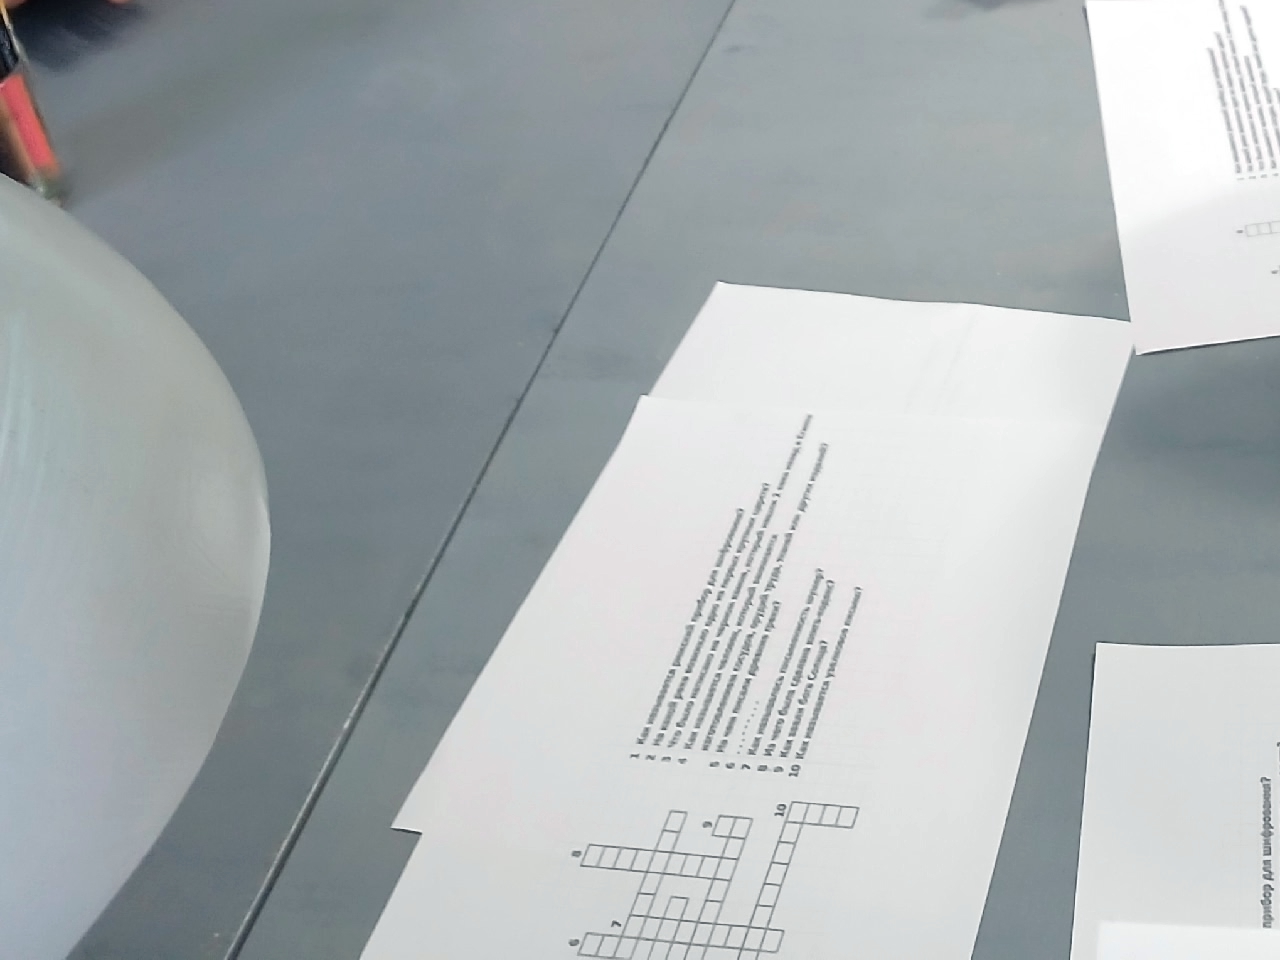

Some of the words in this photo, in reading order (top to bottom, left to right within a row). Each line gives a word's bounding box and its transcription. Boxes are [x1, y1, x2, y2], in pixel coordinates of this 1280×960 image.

[774, 803, 787, 818] 10
[1260, 884, 1274, 928] прибор
[611, 920, 622, 928] 7
